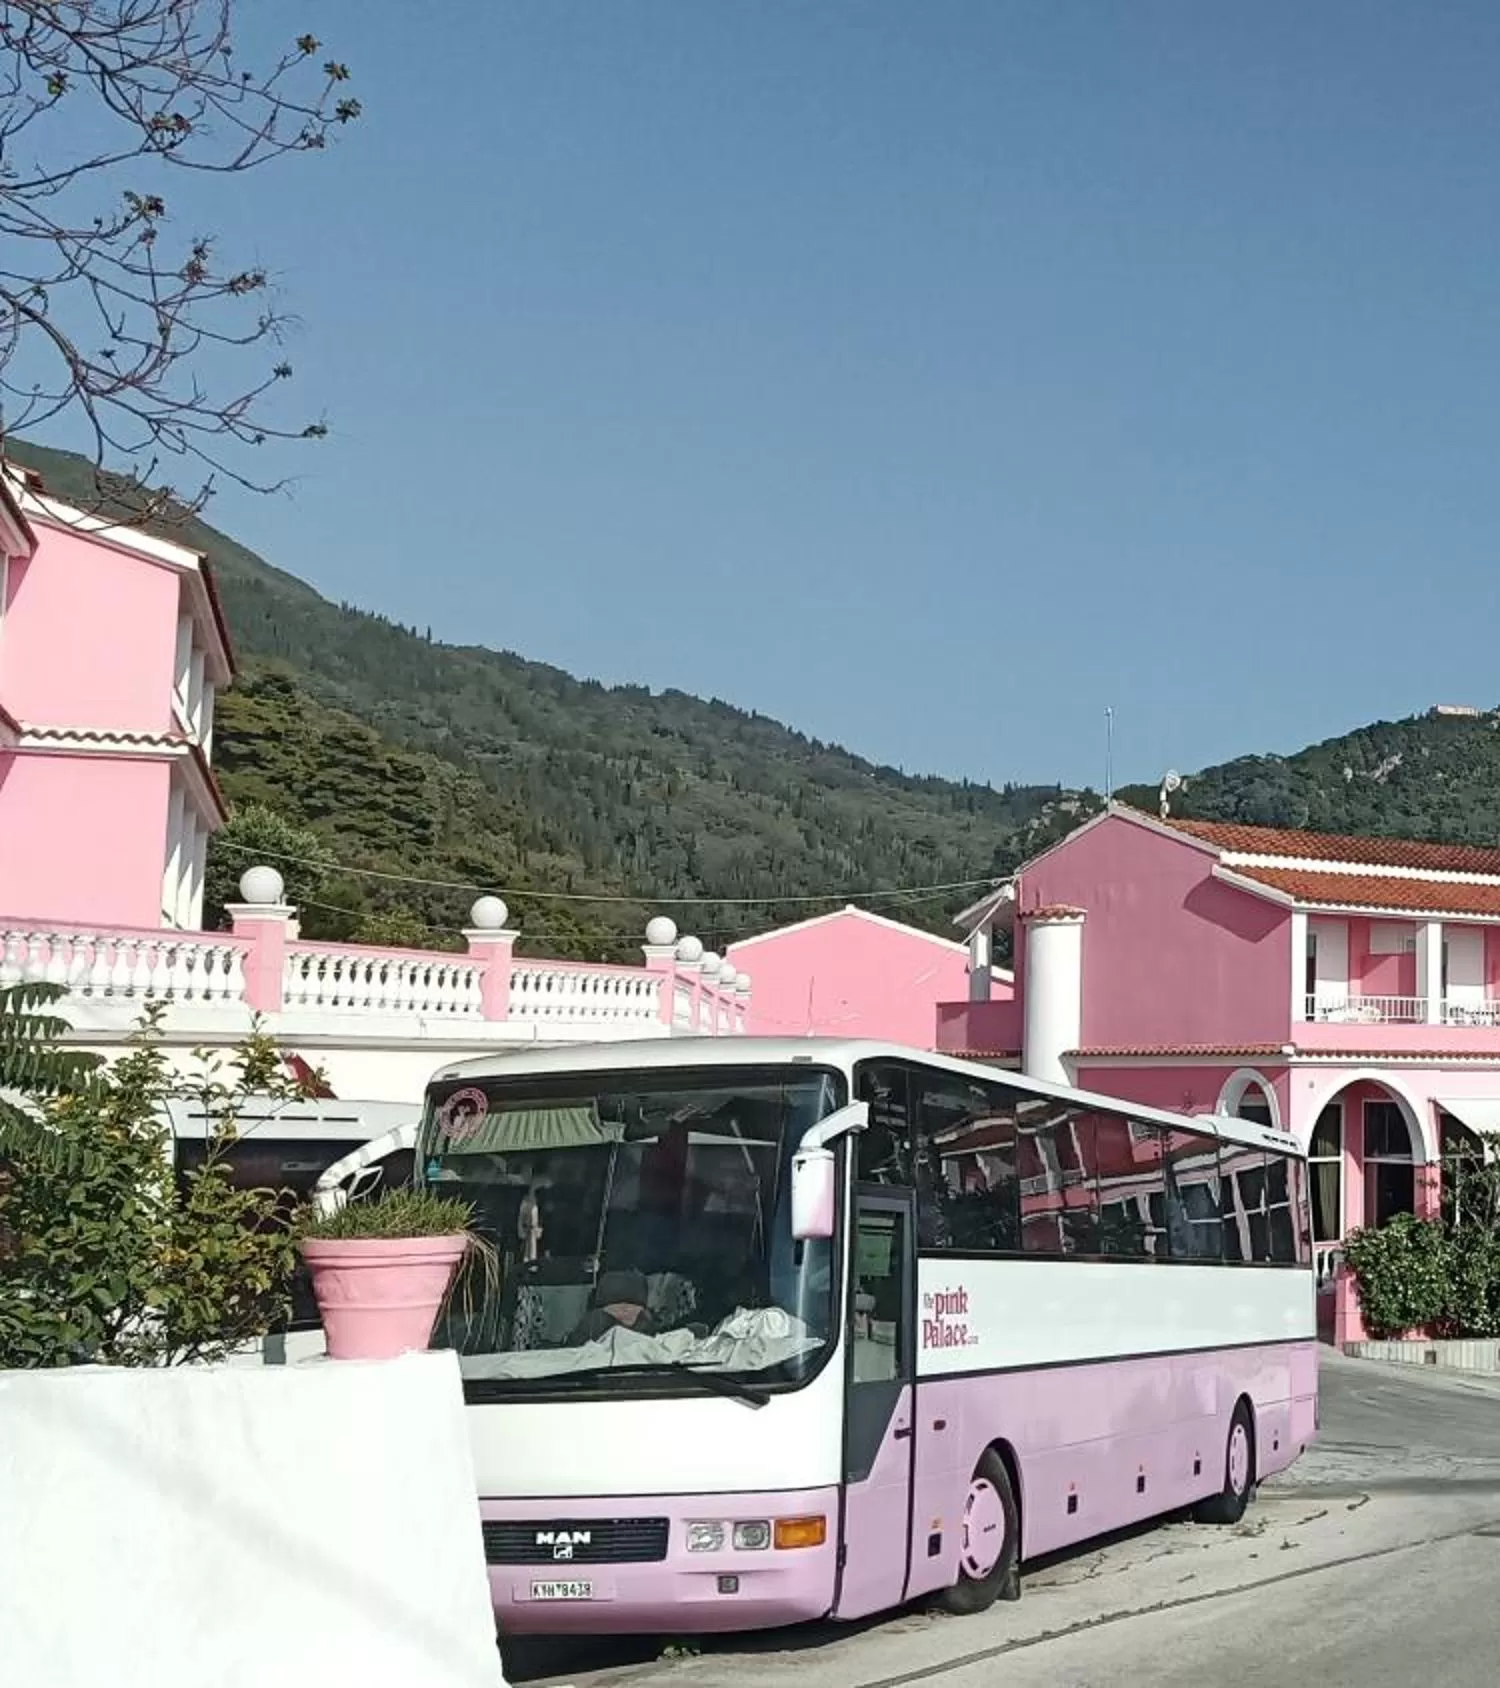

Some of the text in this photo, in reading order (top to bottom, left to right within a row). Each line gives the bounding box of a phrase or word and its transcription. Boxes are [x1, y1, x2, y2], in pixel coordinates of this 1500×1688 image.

[934, 1285, 968, 1321] pink
[922, 1319, 968, 1349] Palace
[535, 1531, 591, 1545] MAN
